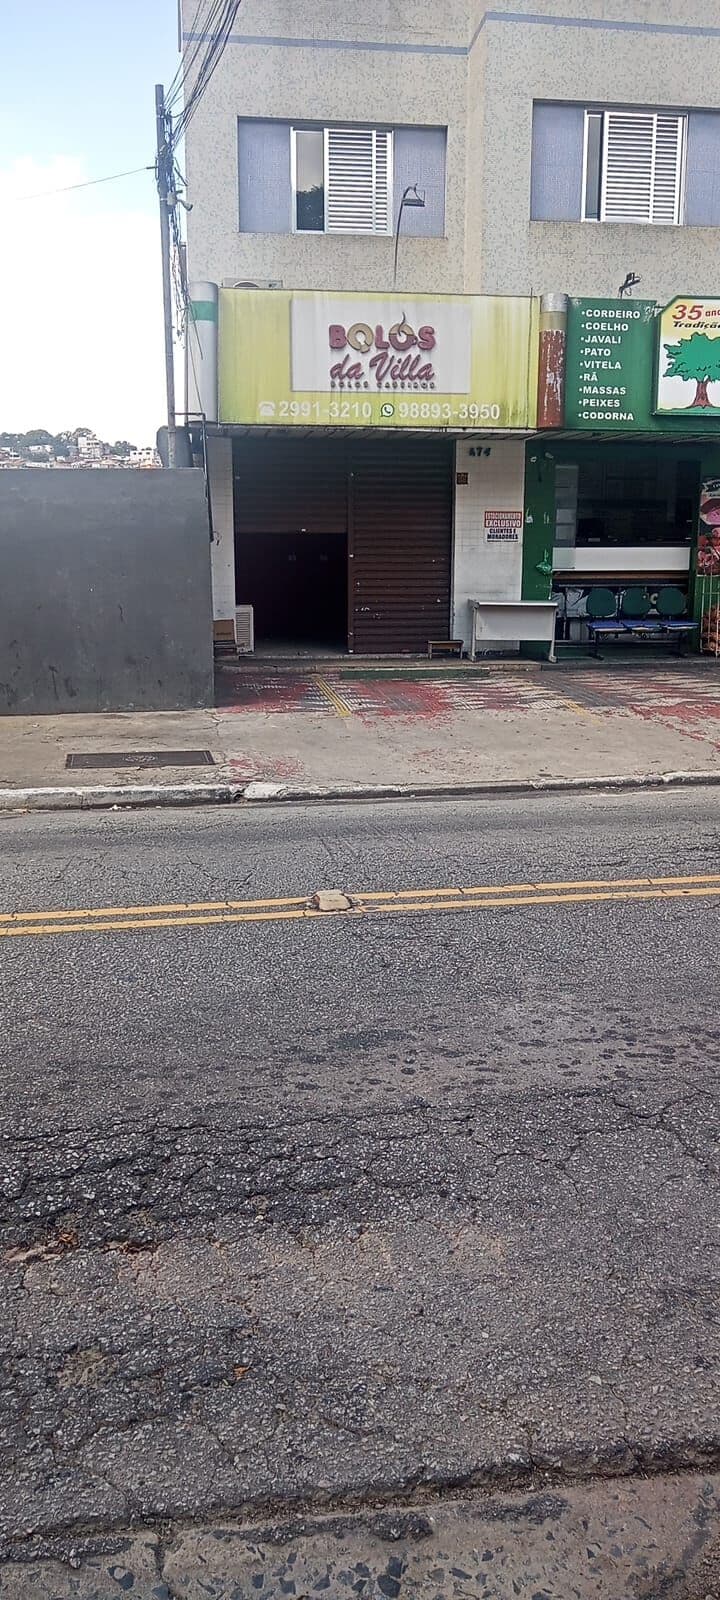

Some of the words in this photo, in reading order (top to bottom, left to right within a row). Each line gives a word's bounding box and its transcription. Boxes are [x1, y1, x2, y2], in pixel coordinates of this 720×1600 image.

[586, 309, 641, 319] CORDEIRO
[672, 304, 704, 320] 35
[585, 322, 629, 332] COELHO
[329, 323, 436, 353] BOLOS
[584, 335, 622, 344] JAVALI
[584, 348, 611, 357] PATO
[330, 354, 365, 381] da
[369, 352, 435, 382] Villa
[584, 361, 622, 370] VITELA
[583, 372, 598, 382] RÃ
[583, 386, 627, 395] MASSAS
[582, 398, 621, 407] PEIXES
[279, 400, 373, 418] 2991-3210
[399, 402, 501, 420] 98893-3950
[582, 411, 634, 421] CODORNA
